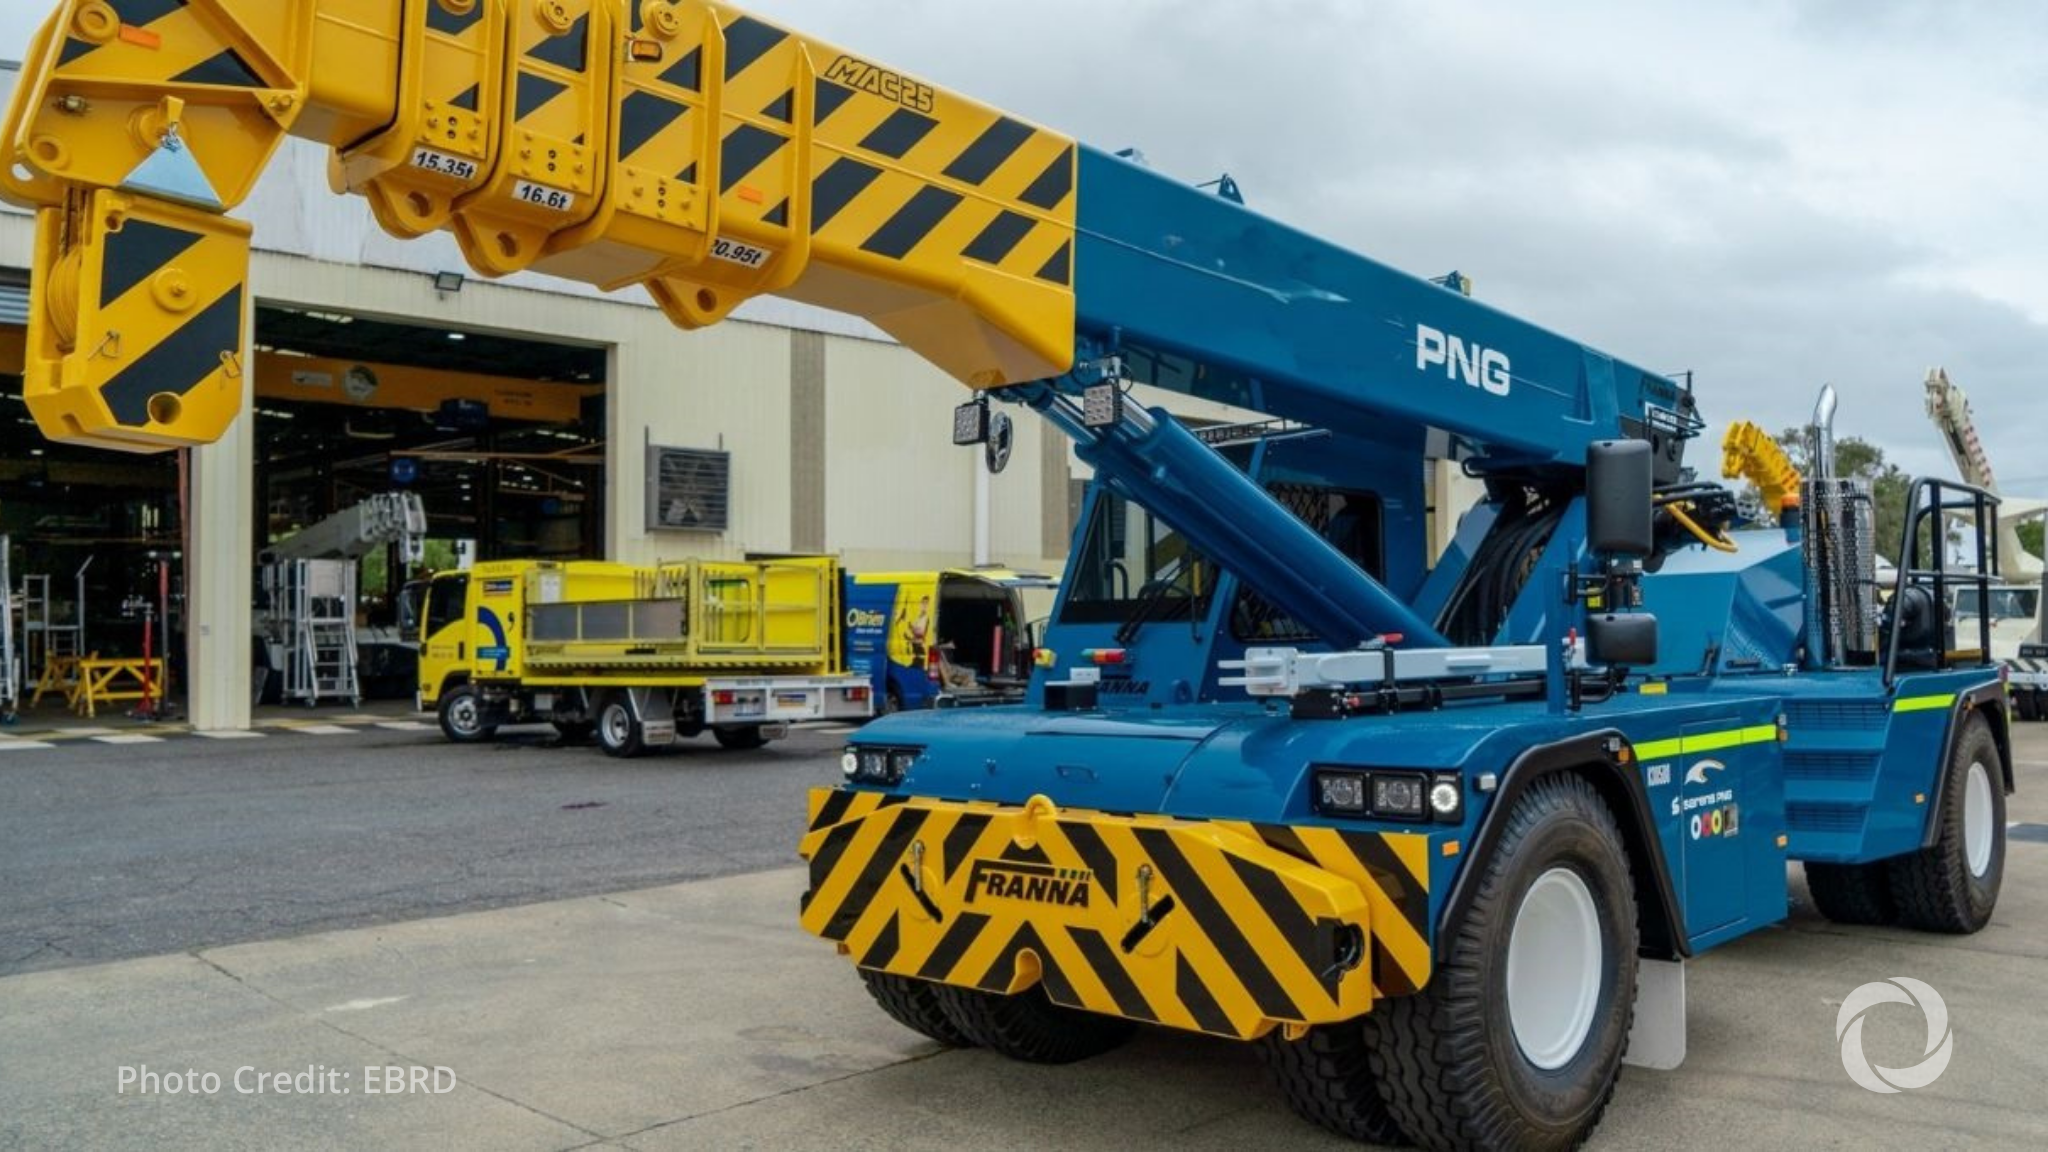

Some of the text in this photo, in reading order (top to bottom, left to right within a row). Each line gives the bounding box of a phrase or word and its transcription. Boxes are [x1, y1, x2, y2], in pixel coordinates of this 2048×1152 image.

[824, 54, 934, 113] MAC25
[417, 151, 474, 178] 15.35t
[521, 184, 568, 208] 16.6t
[1416, 322, 1511, 396] PNG
[964, 858, 1091, 907] FRANNA
